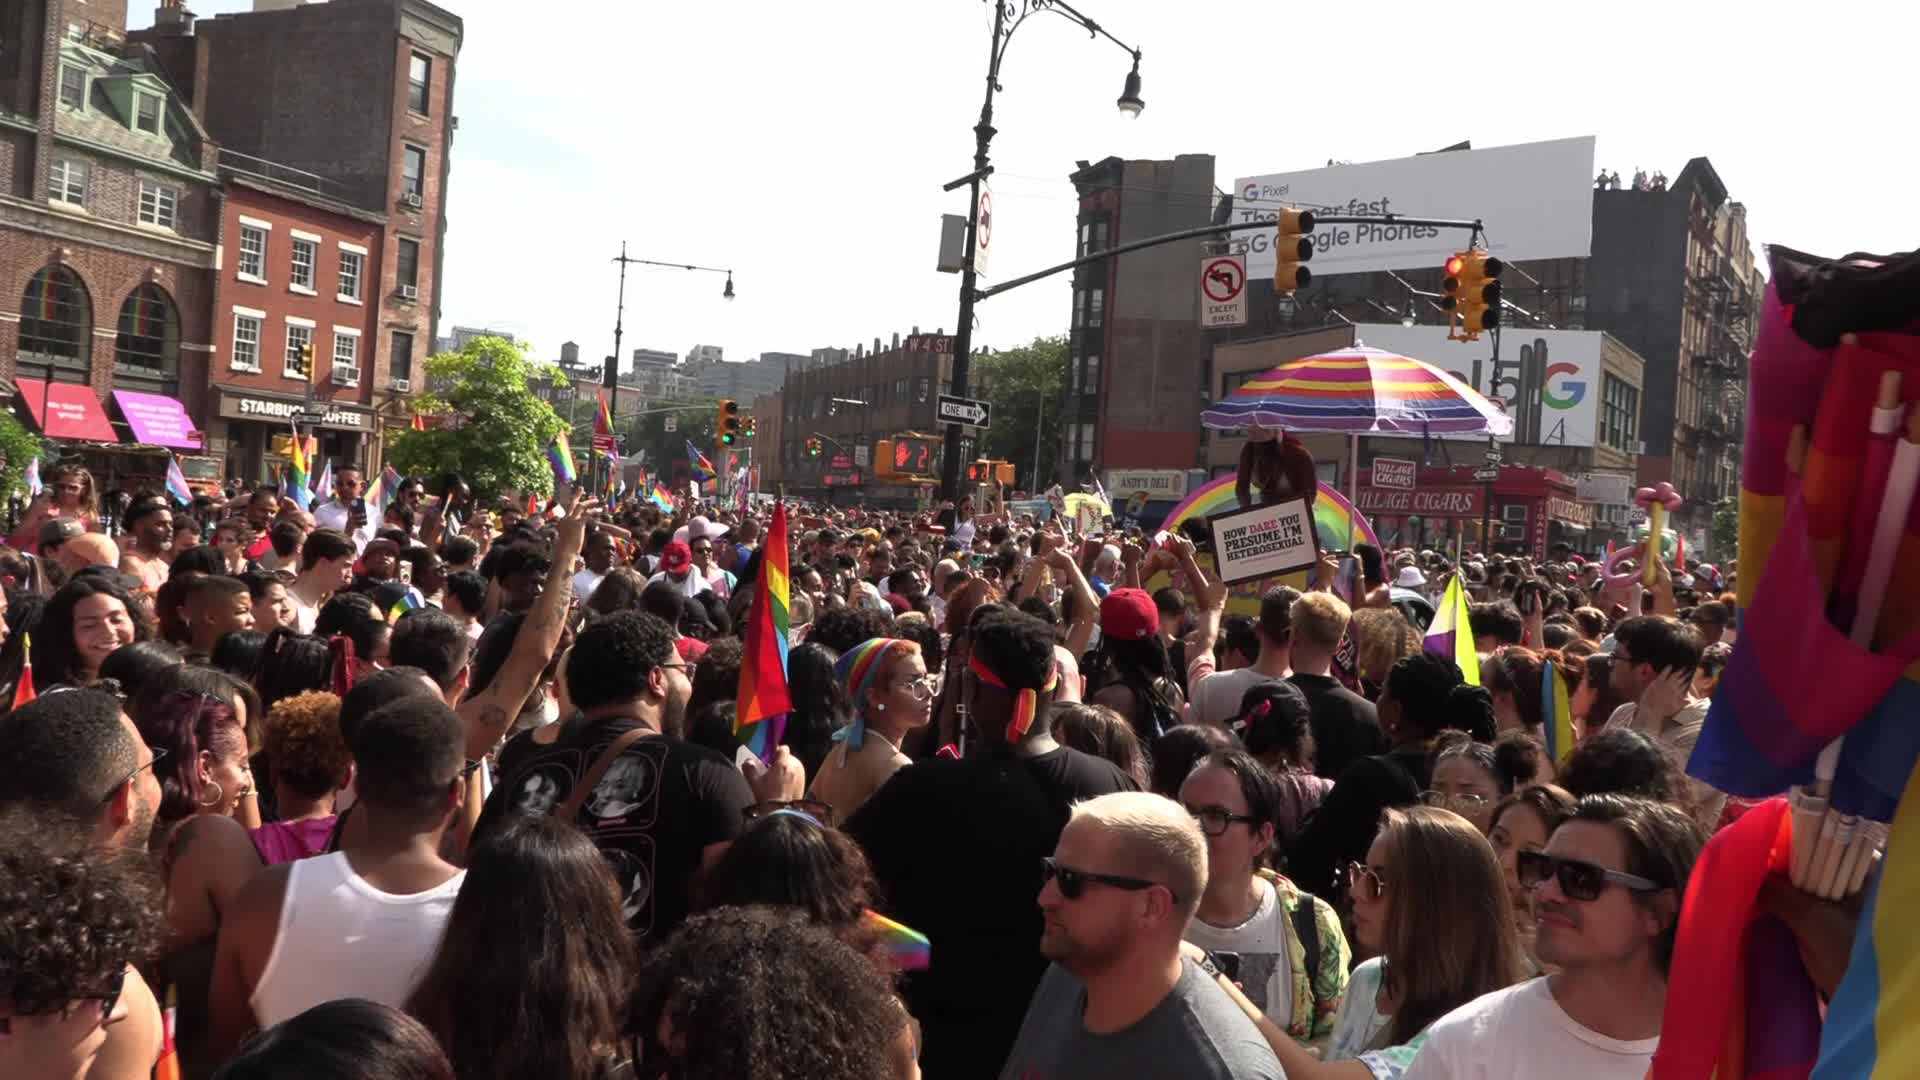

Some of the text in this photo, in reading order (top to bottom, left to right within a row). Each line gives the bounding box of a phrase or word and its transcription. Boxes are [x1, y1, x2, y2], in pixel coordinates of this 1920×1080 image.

[1262, 184, 1288, 198] Pixel
[1349, 197, 1390, 217] fast
[1356, 222, 1439, 244] Phones
[1208, 304, 1238, 313] EXCEPT
[910, 338, 949, 352] W 4 ST
[945, 404, 982, 419] ONE WAY
[917, 446, 928, 469] 2
[1376, 463, 1413, 475] VILLAGE
[1120, 476, 1149, 488] ANDY'S
[1376, 473, 1412, 486] CIGARS
[1414, 492, 1472, 512] CIGARS
[1223, 513, 1300, 540] HOW DARE YOU
[1224, 524, 1302, 552] PRESUME I'M
[1226, 537, 1305, 561] HETEROSEXUAL
